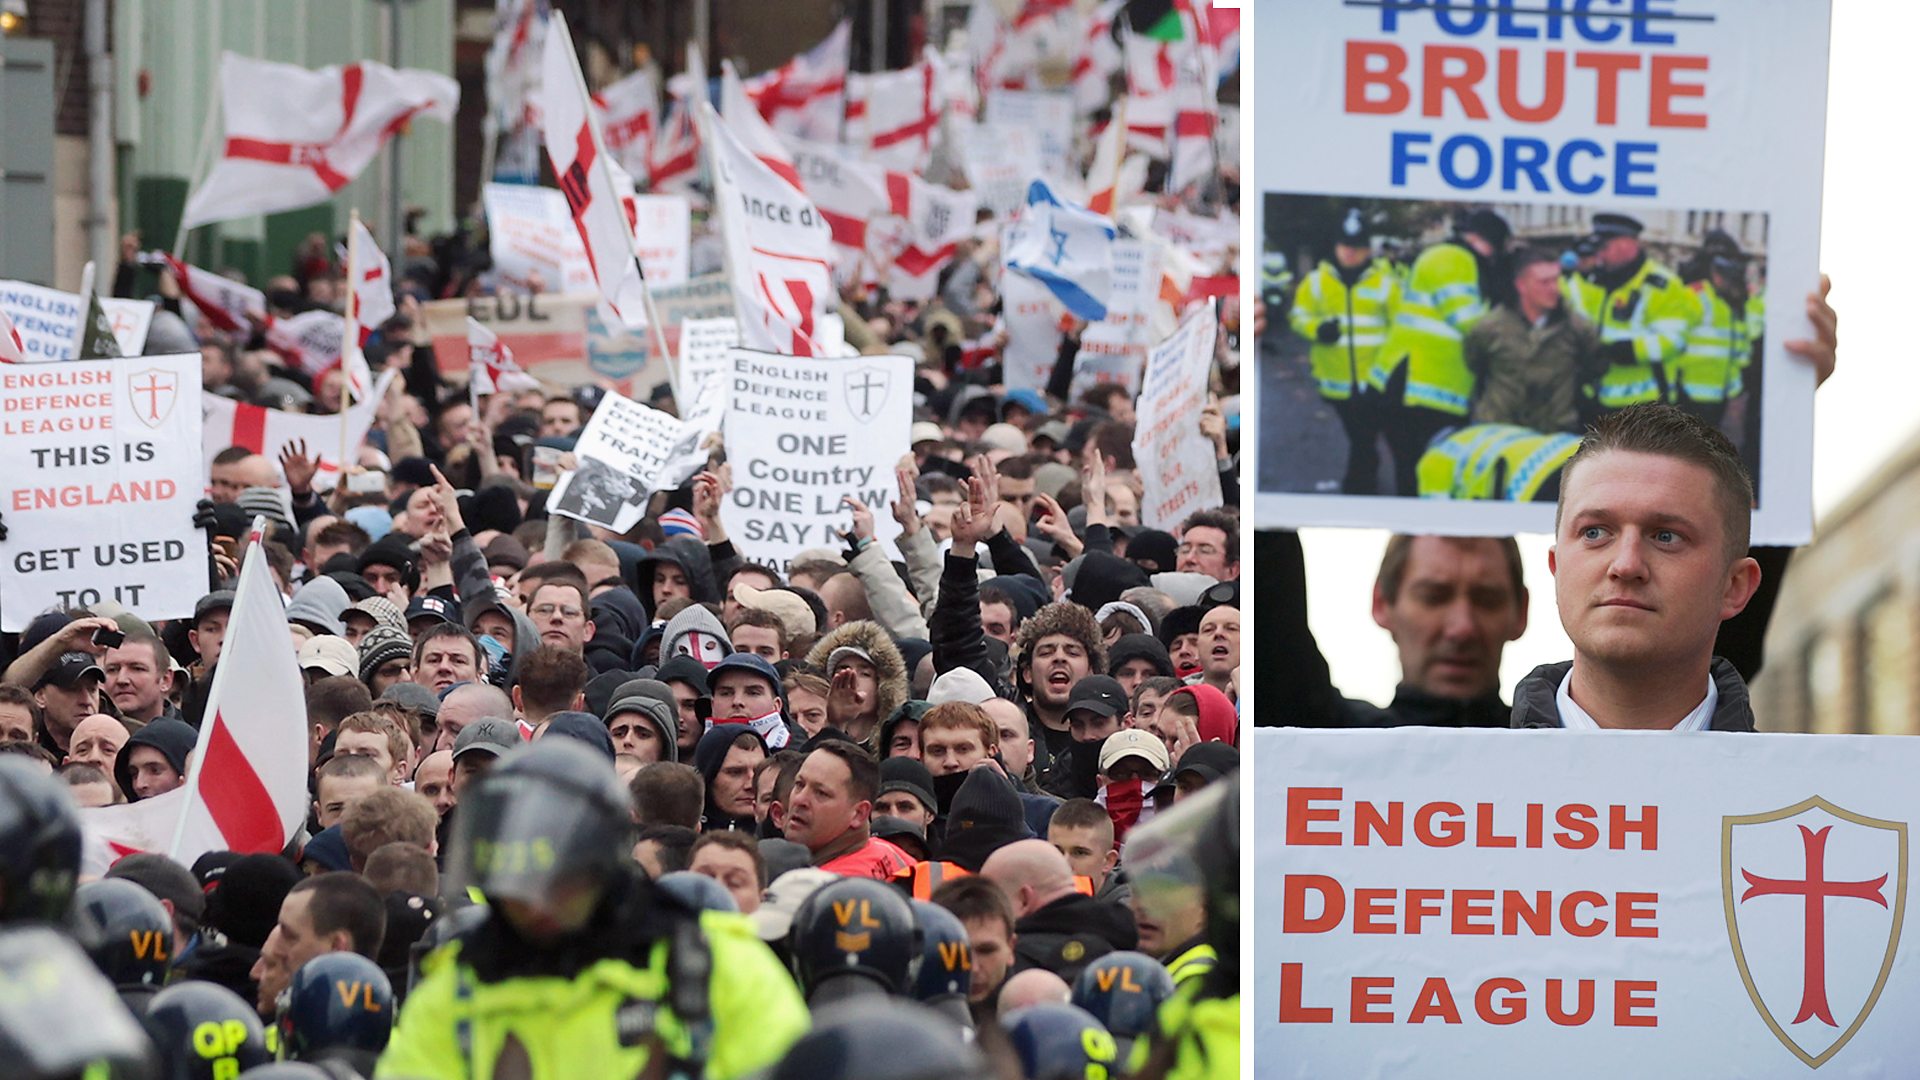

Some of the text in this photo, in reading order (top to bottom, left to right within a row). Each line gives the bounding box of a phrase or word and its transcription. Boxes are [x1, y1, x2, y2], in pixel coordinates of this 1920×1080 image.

[1380, 0, 1678, 46] POLICE
[1344, 40, 1709, 129] BRUTE
[1389, 130, 1660, 198] FORCE
[0, 291, 80, 319] NGLISH
[5, 310, 76, 339] FENCE
[3, 371, 113, 389] ENGLISH
[735, 359, 828, 382] ENGLISH
[3, 393, 113, 412] DEFENCE
[734, 378, 828, 402] DEFENCE
[734, 398, 827, 421] LEAGUE
[4, 415, 113, 435] LEAGUE
[31, 442, 155, 468] THIS IS
[777, 433, 847, 456] ONE
[748, 458, 874, 487] Country
[11, 479, 177, 512] ENGLAND
[732, 487, 887, 516] ONE LAW
[744, 519, 812, 545] SAY
[14, 540, 185, 573] GET USED
[115, 585, 146, 607] IT
[1286, 787, 1658, 851] ENGLISH
[832, 899, 880, 928] VL
[1282, 874, 1659, 938] DEFENCE
[130, 929, 167, 961] VL
[938, 941, 971, 971] VL
[1096, 967, 1142, 993] VL
[335, 980, 382, 1013] VL
[1278, 963, 1658, 1027] LEAGUE
